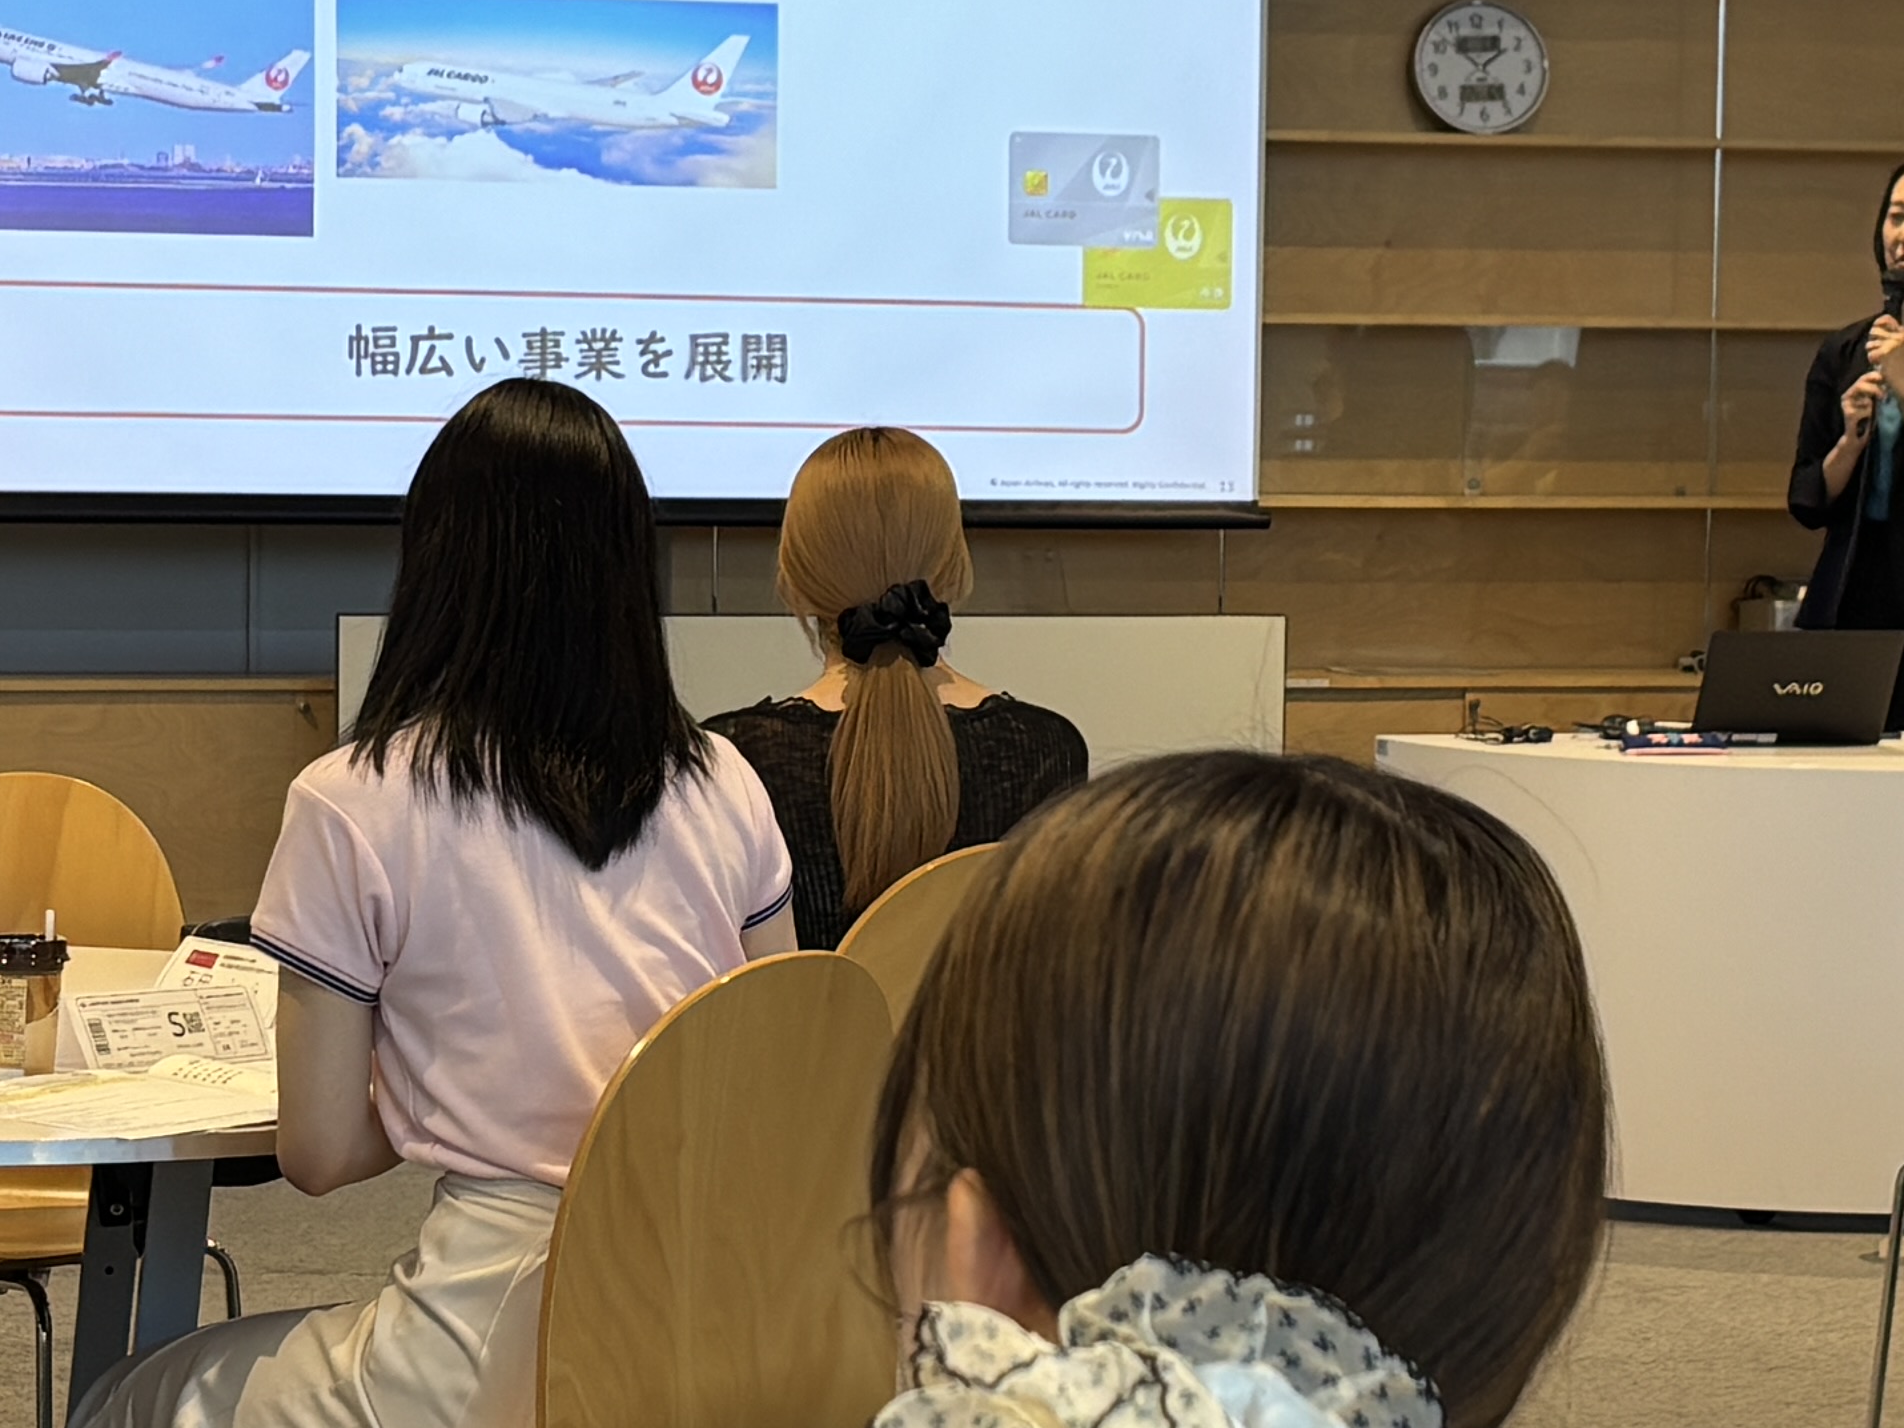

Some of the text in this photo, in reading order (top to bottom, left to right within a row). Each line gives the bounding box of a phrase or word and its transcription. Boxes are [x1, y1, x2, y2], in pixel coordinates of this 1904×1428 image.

[347, 323, 789, 384] 幅広い事業を展開
[1773, 681, 1824, 695] VAIO
[167, 1011, 187, 1037] S
